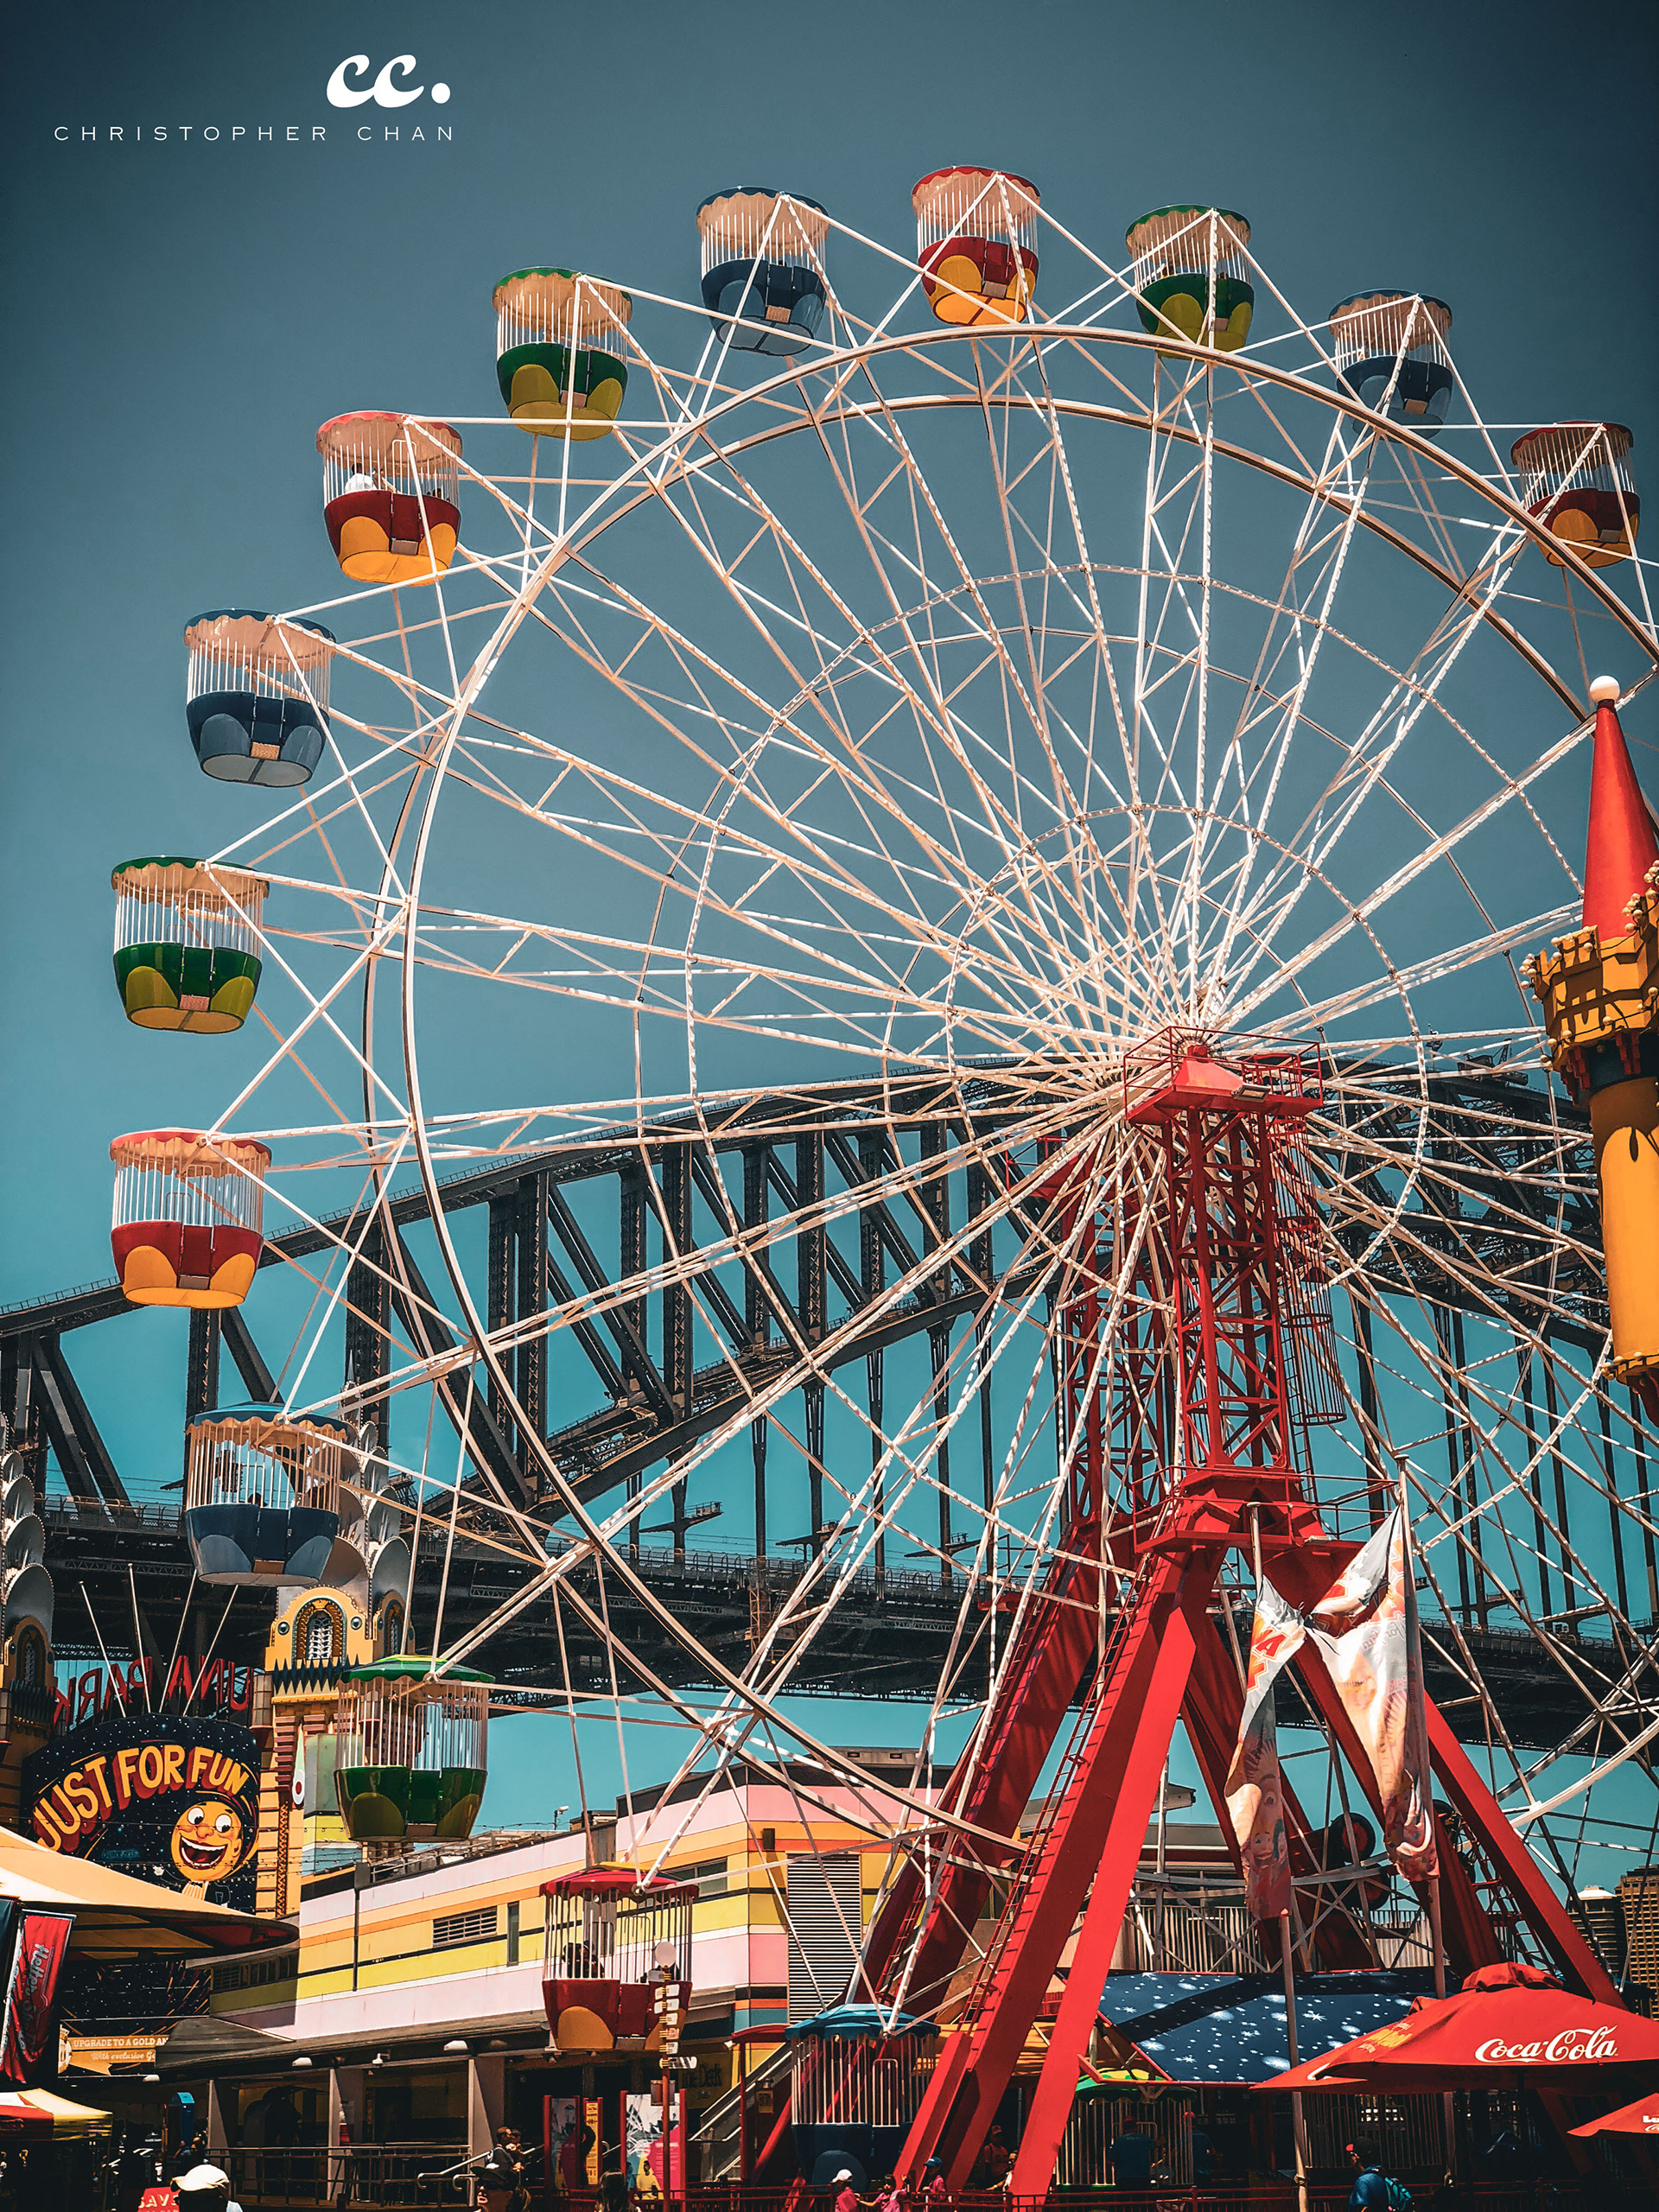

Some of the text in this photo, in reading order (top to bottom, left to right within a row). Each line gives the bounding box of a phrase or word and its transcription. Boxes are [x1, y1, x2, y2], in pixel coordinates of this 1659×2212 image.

[32, 1744, 250, 1853] JUST FOR FUN
[73, 2037, 112, 2048] UPGRADE
[112, 2038, 124, 2047] TO
[133, 2037, 156, 2046] GOLD
[1475, 2024, 1618, 2063] Coca-Cola
[91, 2052, 110, 2061] With
[111, 2051, 144, 2060] exclusive
